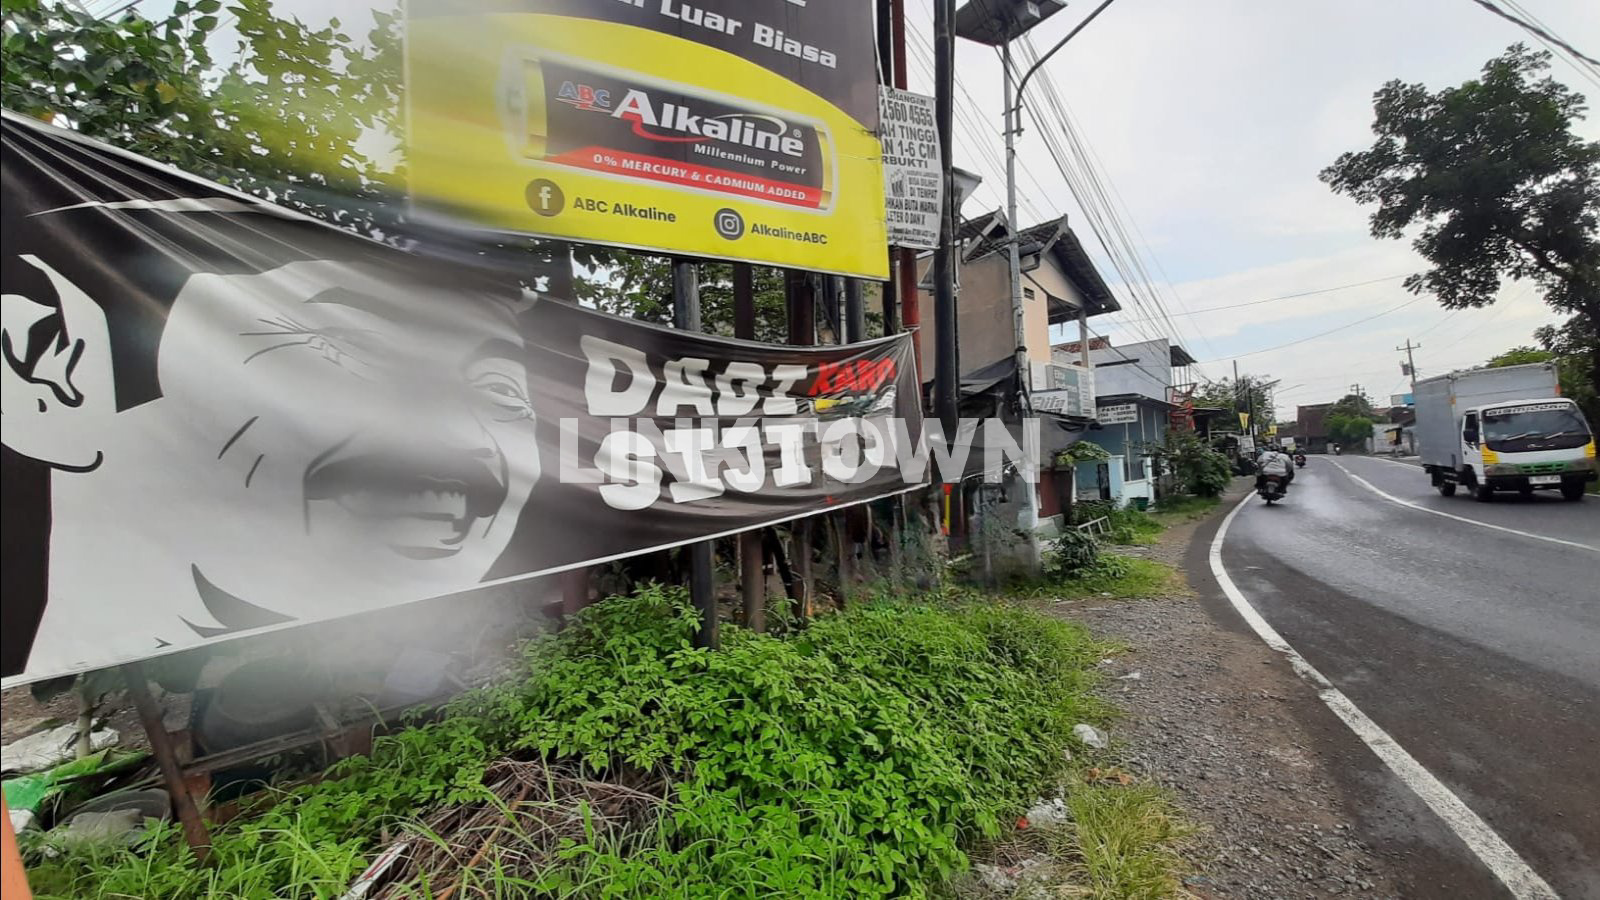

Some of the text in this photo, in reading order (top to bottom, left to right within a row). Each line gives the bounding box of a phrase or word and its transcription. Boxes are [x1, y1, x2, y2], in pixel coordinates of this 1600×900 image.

[660, 0, 837, 69] Luar Biasa
[558, 81, 804, 158] ABC Alkaline
[909, 105, 933, 127] 4555
[898, 125, 937, 143] TINGGI
[694, 143, 807, 175] Millennium Power
[898, 140, 916, 157] 1-6
[919, 143, 937, 160] CM
[593, 154, 806, 201] 0% MERCURY & CADMIUM ADDED
[573, 197, 677, 223] ABC Alkaline
[751, 223, 828, 245] AlkalineABC
